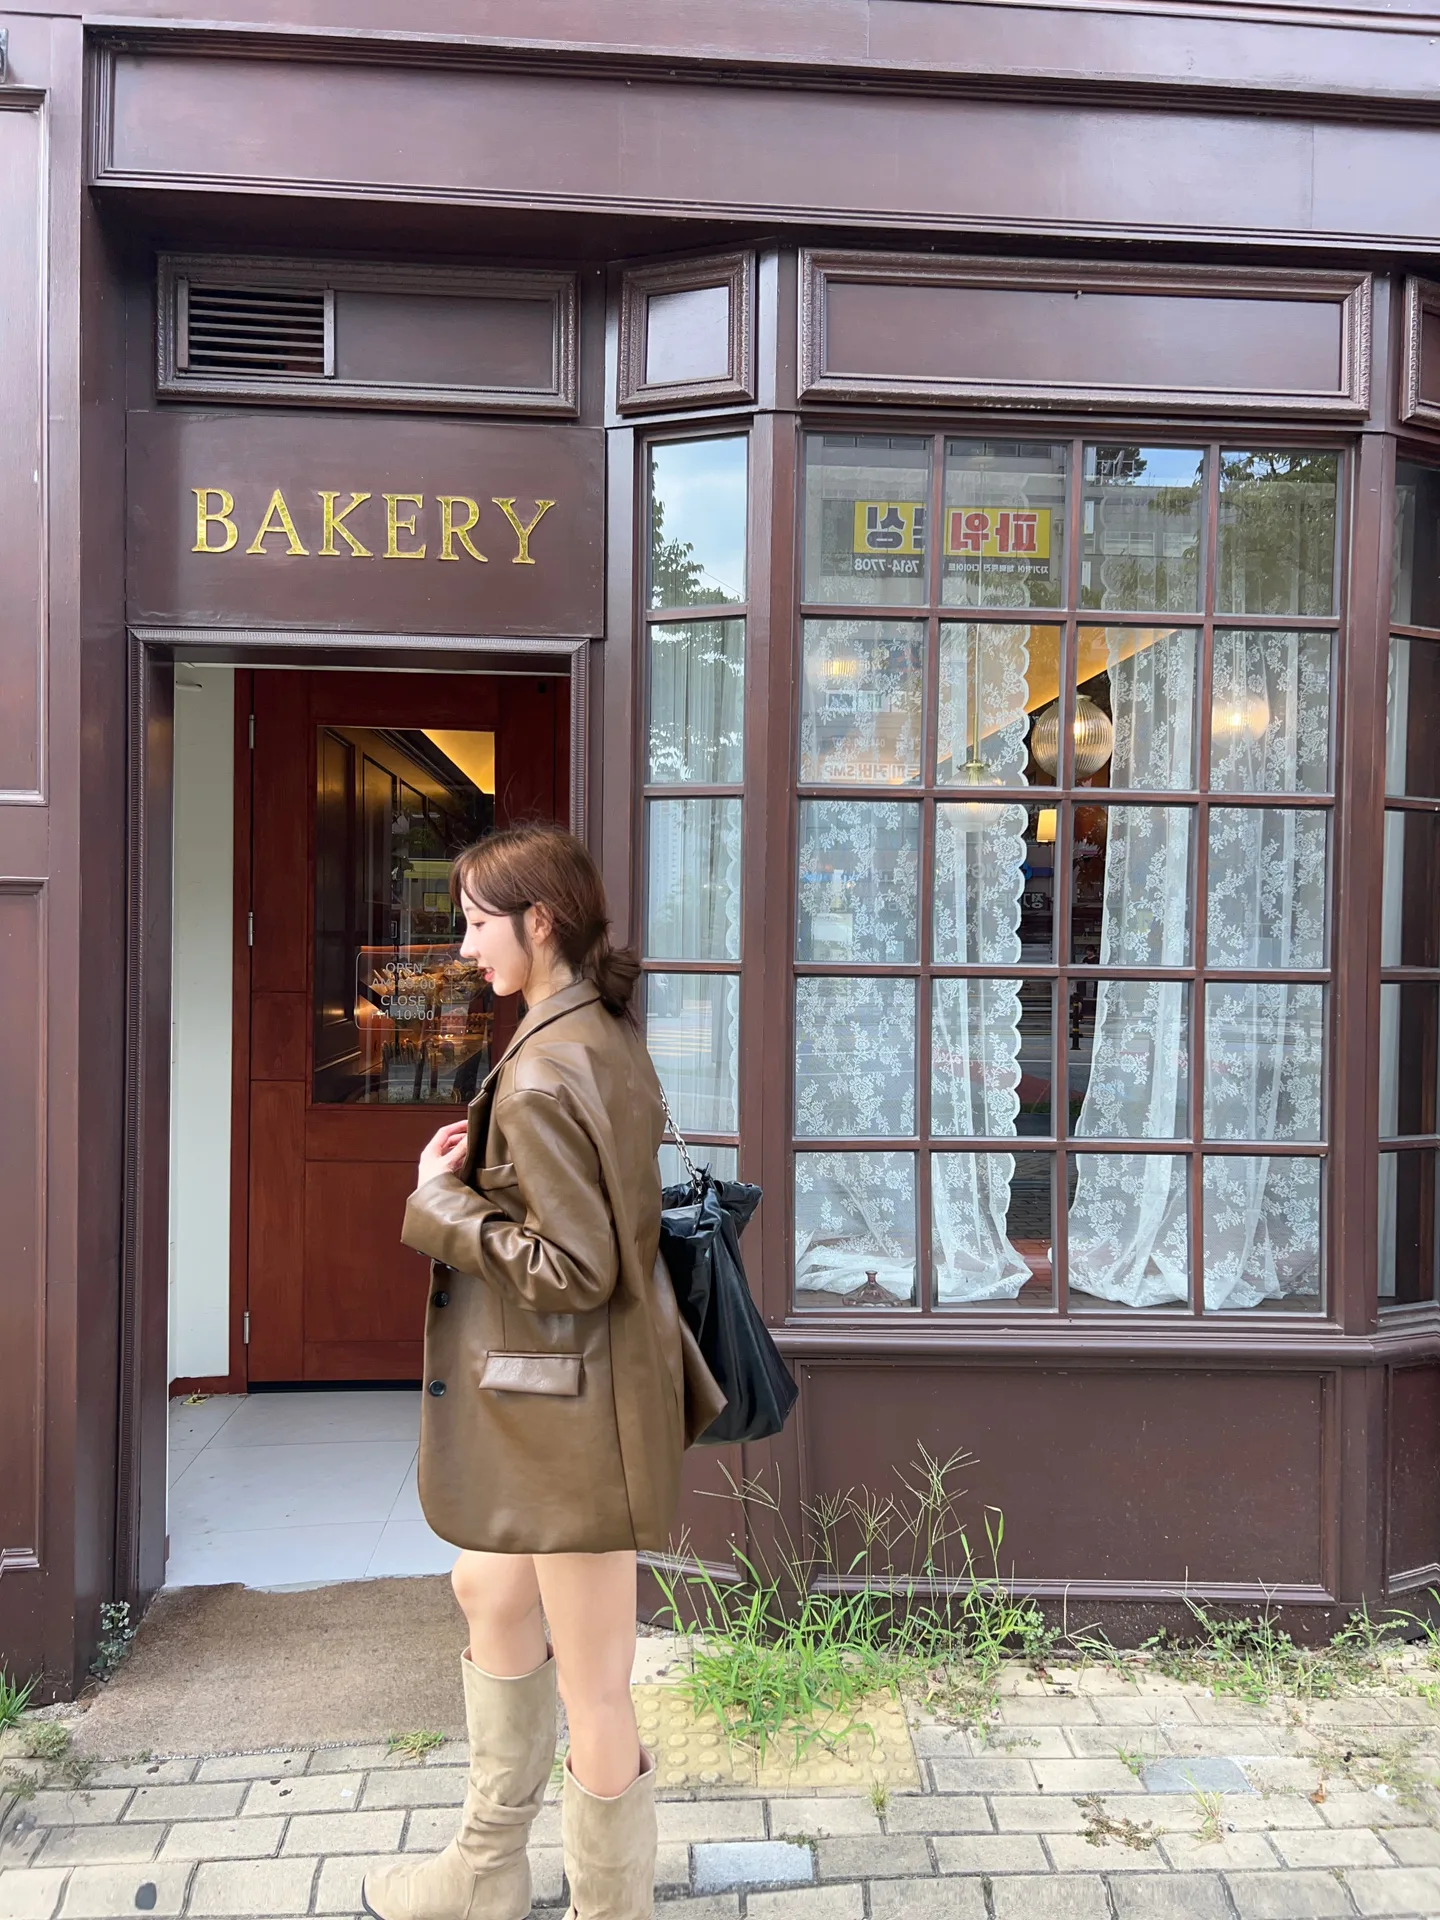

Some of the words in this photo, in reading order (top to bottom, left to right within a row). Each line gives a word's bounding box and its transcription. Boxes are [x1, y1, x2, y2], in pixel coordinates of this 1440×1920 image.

[191, 487, 557, 565] BAKERY
[386, 962, 423, 974] OPEN
[380, 995, 426, 1007] CLOSE
[371, 1009, 390, 1020] PM
[396, 1009, 434, 1021] 10:00
